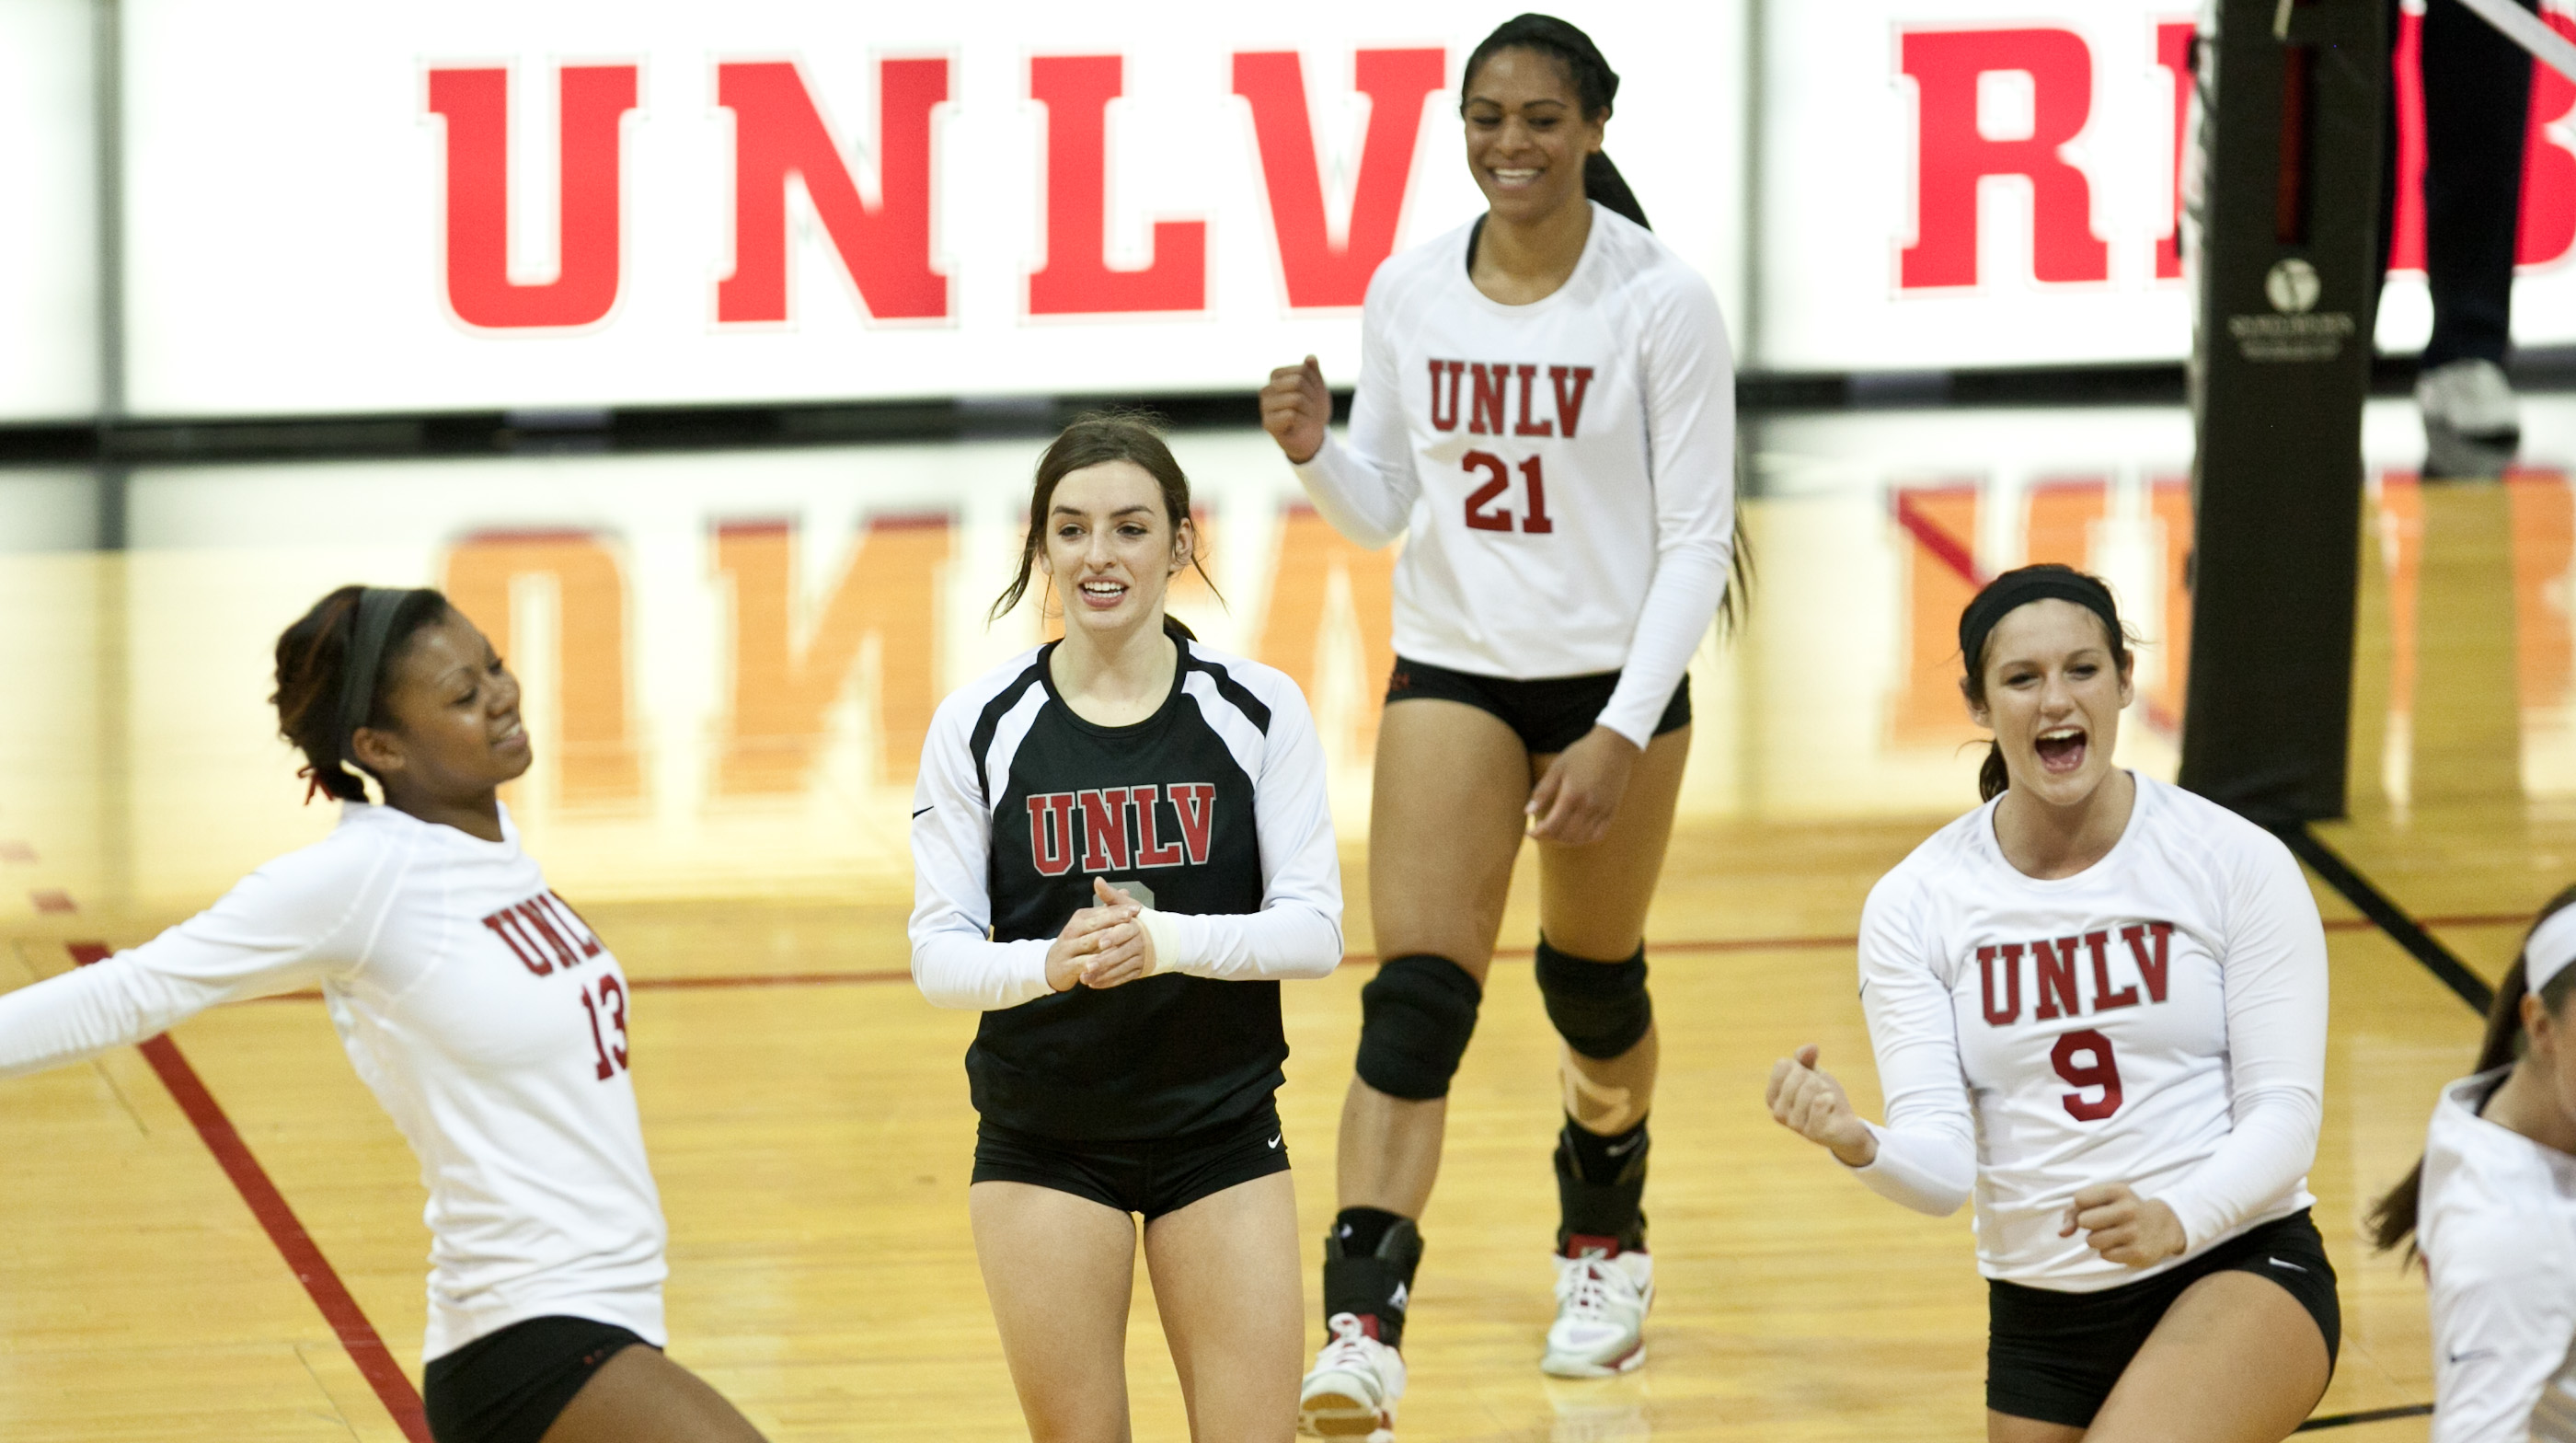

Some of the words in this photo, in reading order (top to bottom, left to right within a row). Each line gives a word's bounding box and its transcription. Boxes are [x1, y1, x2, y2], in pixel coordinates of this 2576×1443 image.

[424, 46, 1448, 331] UNLV
[1428, 358, 1593, 438] UNLV
[1462, 448, 1553, 534] 21
[1026, 782, 1217, 877] UNLV
[481, 888, 604, 977] UNL
[1975, 920, 2175, 1028] UNLV
[581, 973, 628, 1081] 13
[2050, 1028, 2123, 1122] 9
